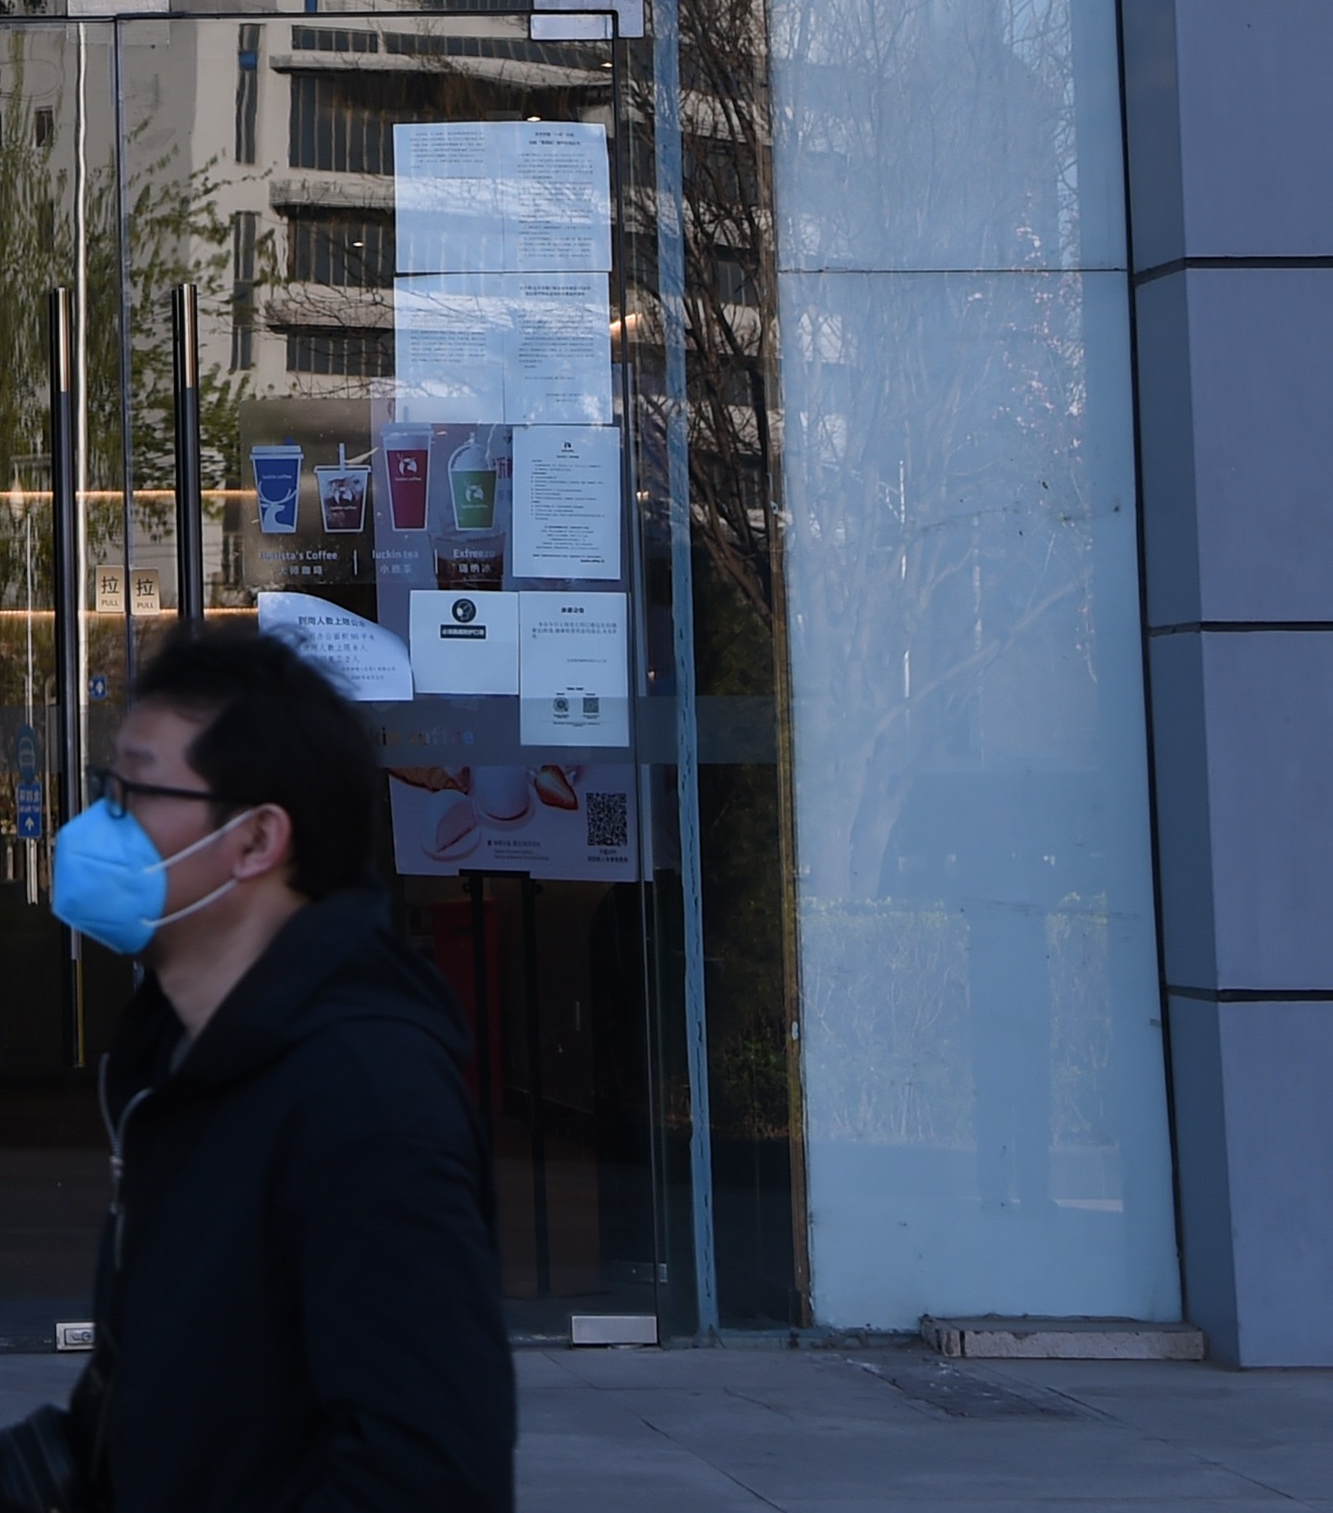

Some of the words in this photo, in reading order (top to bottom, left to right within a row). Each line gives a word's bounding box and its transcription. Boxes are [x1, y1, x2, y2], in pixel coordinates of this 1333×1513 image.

[306, 550, 338, 561] Coffee
[100, 574, 121, 595] 拉
[135, 577, 156, 598] 拉
[100, 598, 119, 607] PULL
[136, 601, 155, 610] PULL
